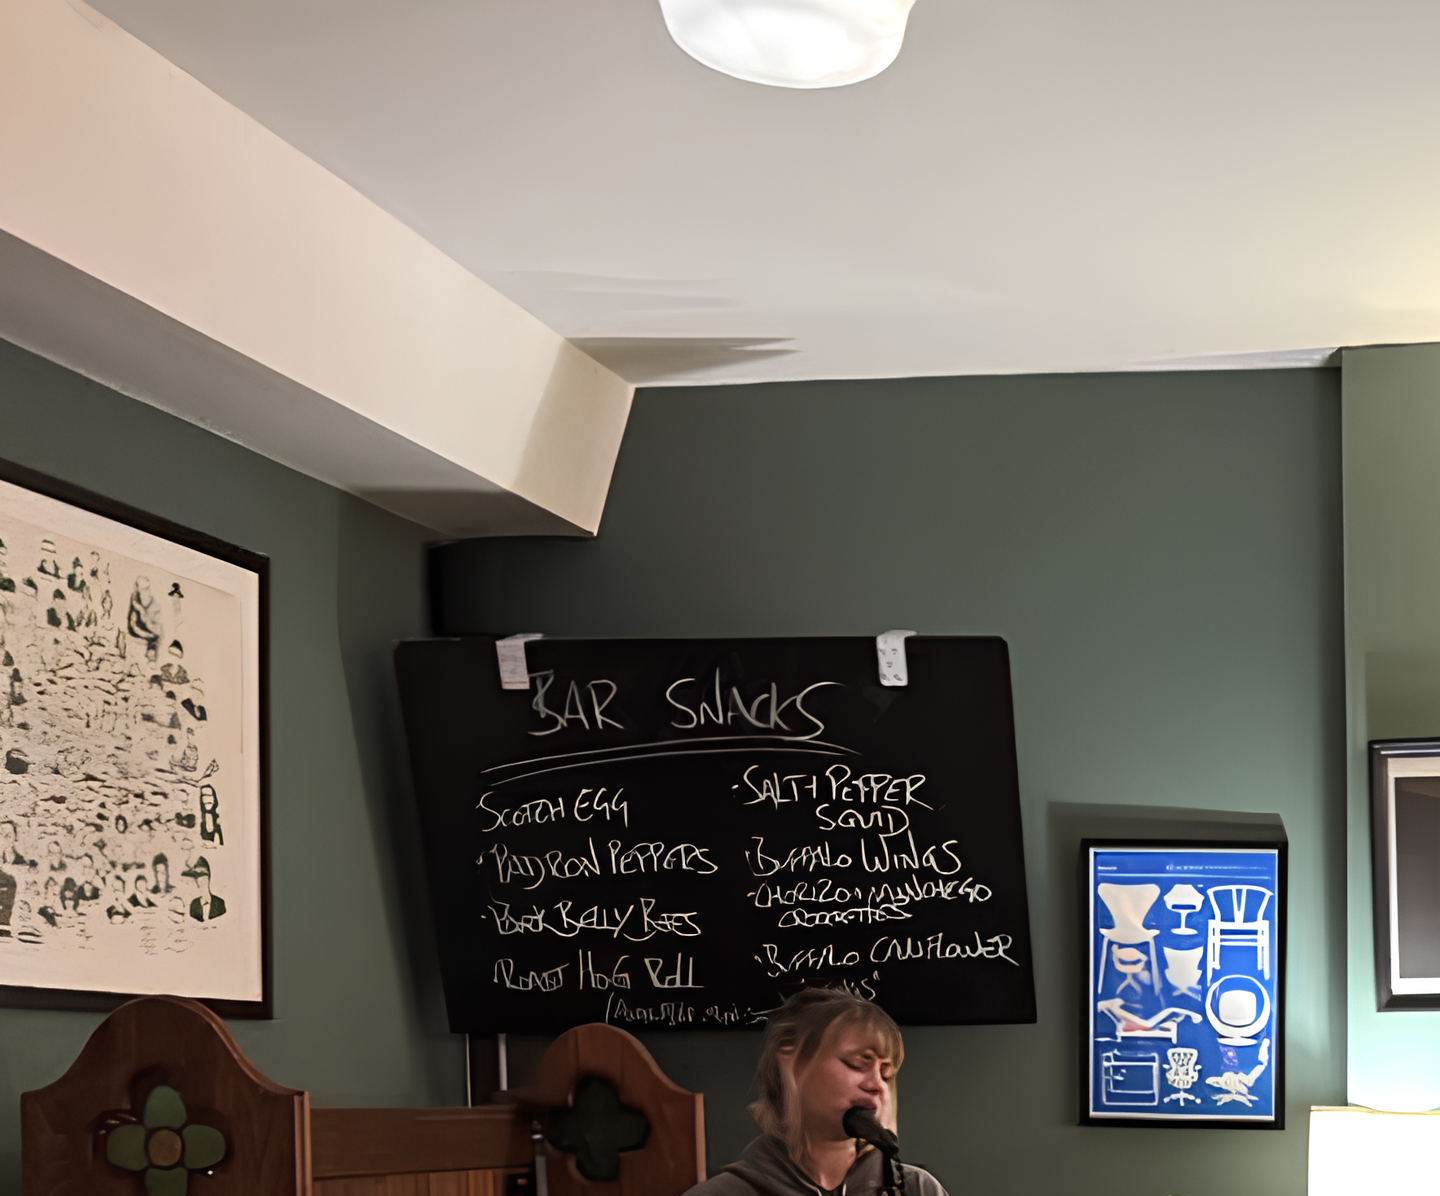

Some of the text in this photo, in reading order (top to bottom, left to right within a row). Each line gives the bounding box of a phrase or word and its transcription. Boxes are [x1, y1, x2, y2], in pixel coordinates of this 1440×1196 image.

[528, 667, 847, 741] BAR SNACKS
[475, 787, 629, 832] SCOTCH EGG
[825, 764, 934, 811] PEPPER
[861, 829, 962, 875] WINGS
